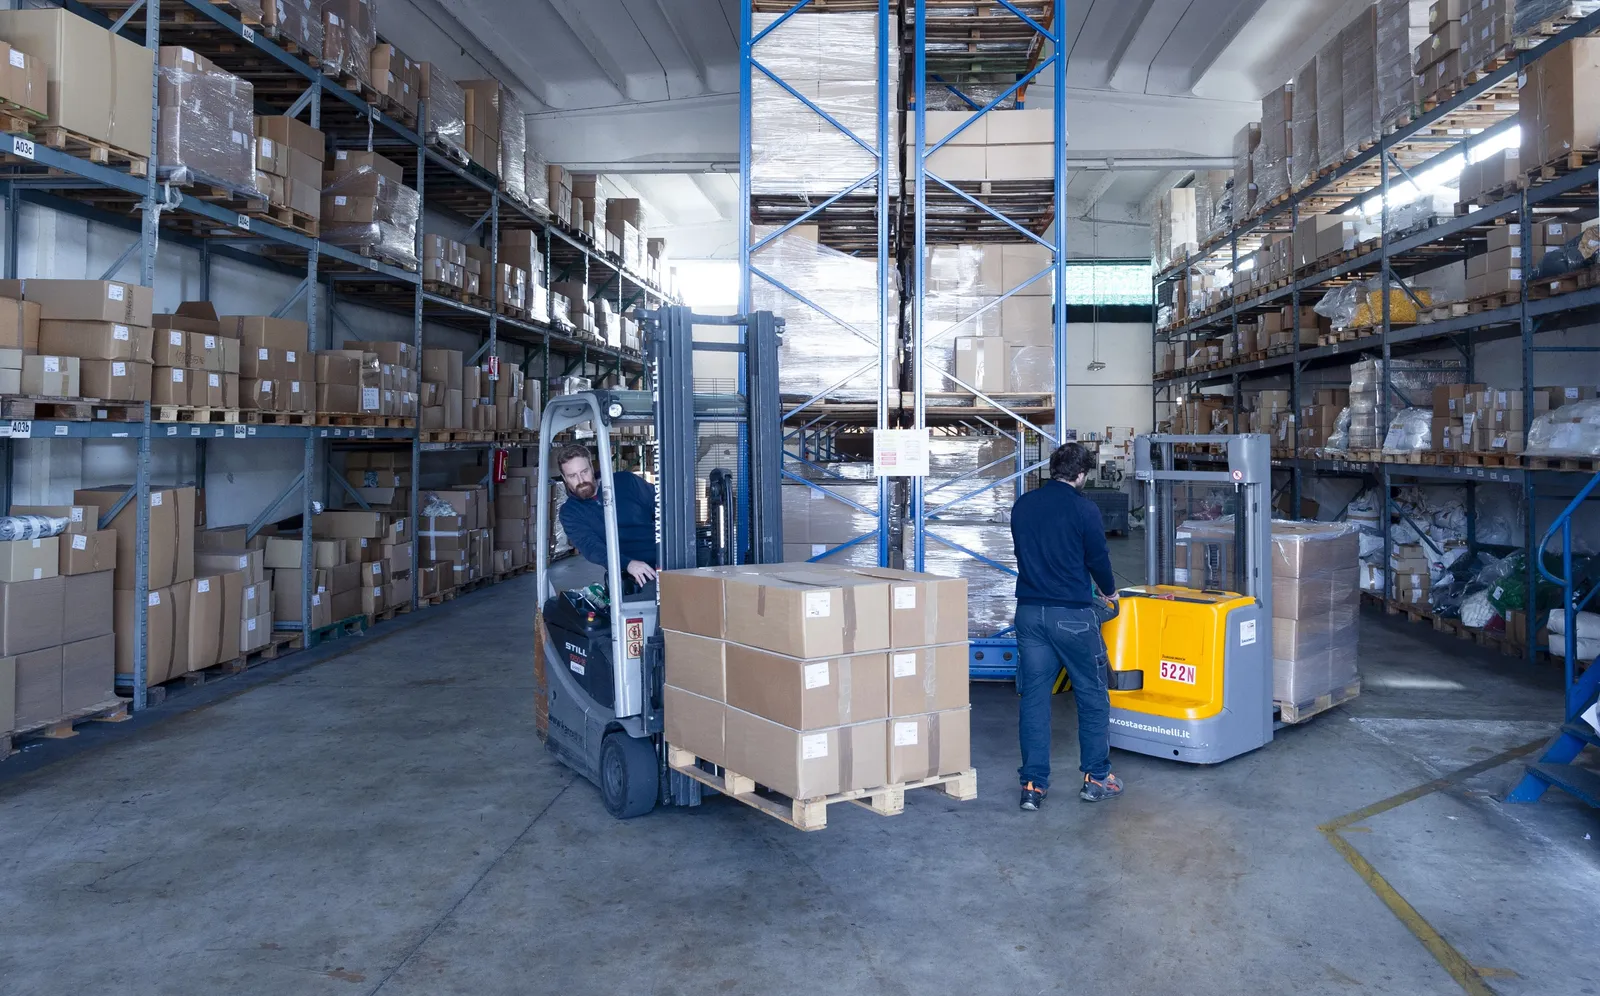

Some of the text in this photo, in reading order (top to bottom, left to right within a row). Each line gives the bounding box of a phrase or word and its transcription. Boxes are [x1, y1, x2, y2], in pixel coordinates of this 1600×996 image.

[15, 140, 33, 155] A03c
[12, 422, 30, 433] A03b
[565, 641, 588, 658] STILL
[1161, 662, 1195, 683] 522N
